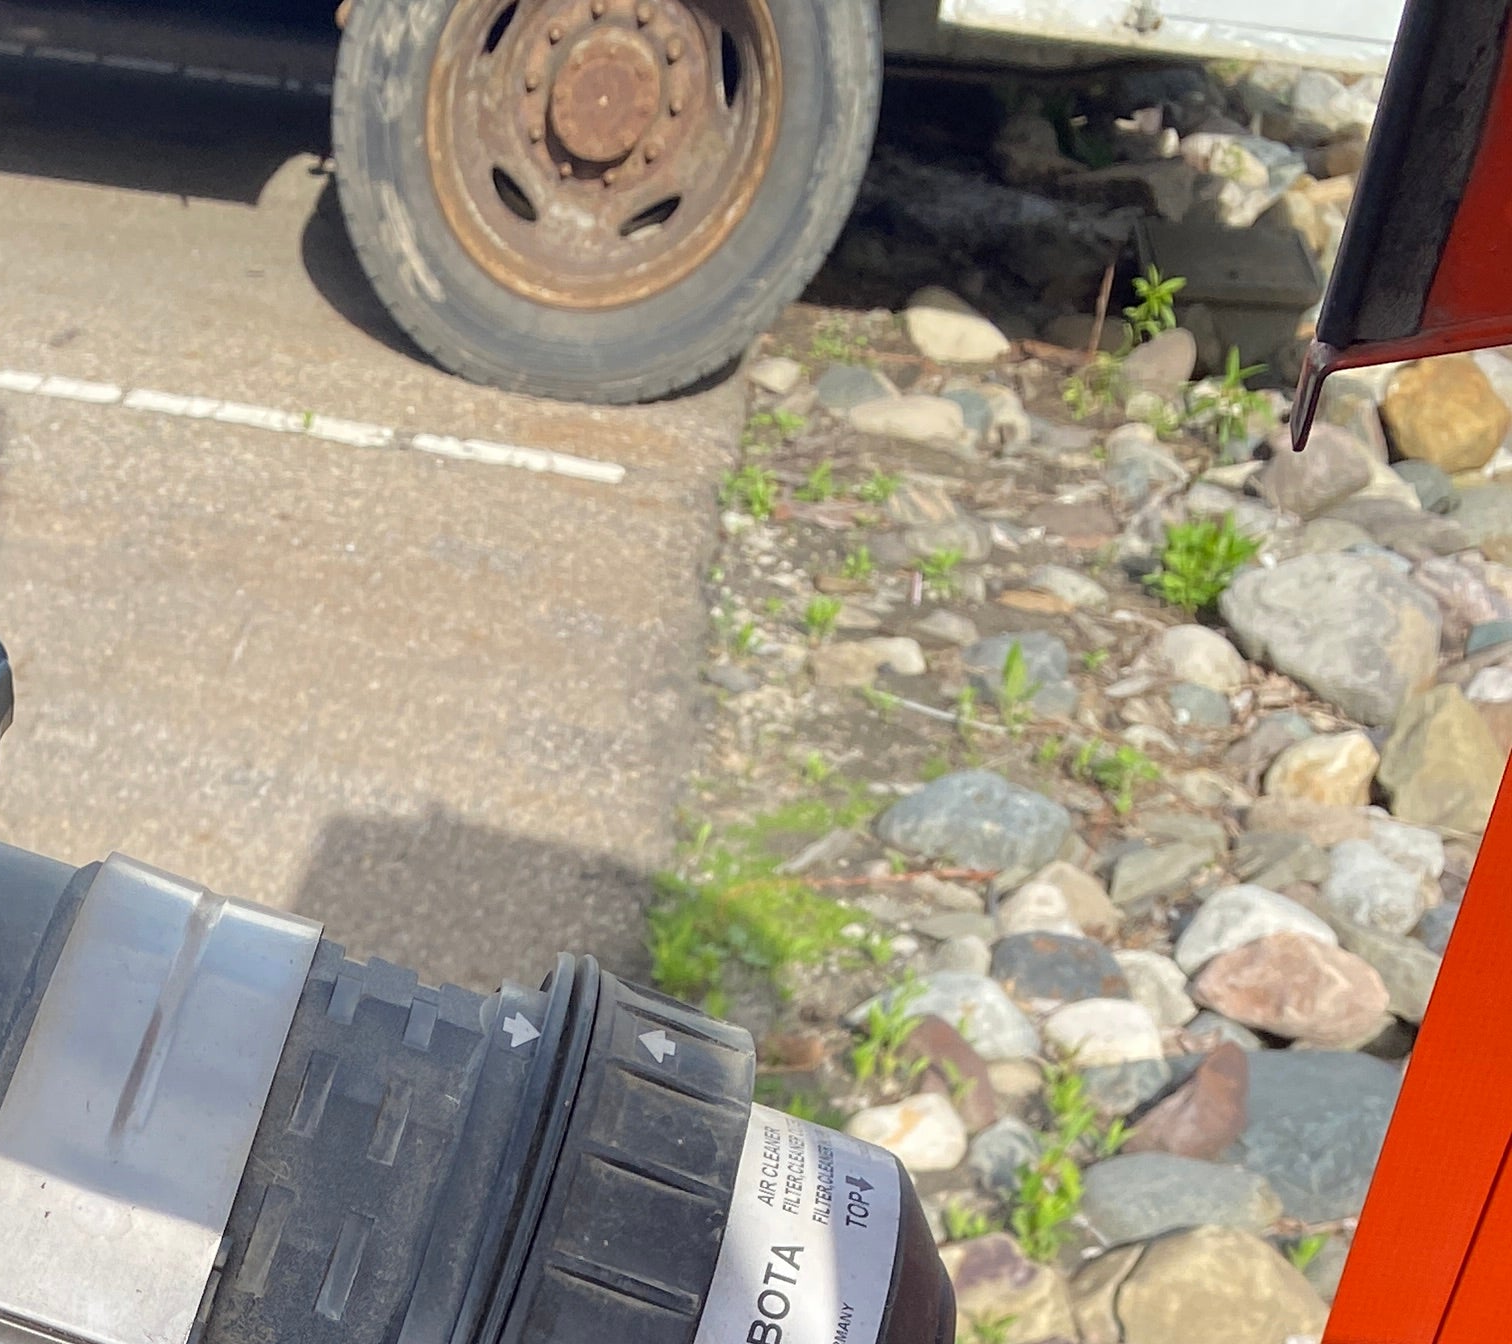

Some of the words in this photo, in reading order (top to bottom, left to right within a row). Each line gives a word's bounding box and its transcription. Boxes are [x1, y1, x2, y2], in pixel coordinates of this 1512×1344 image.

[761, 1125, 781, 1172] CLEANER
[757, 1174, 778, 1208] AIR
[845, 1191, 874, 1230] TOP
